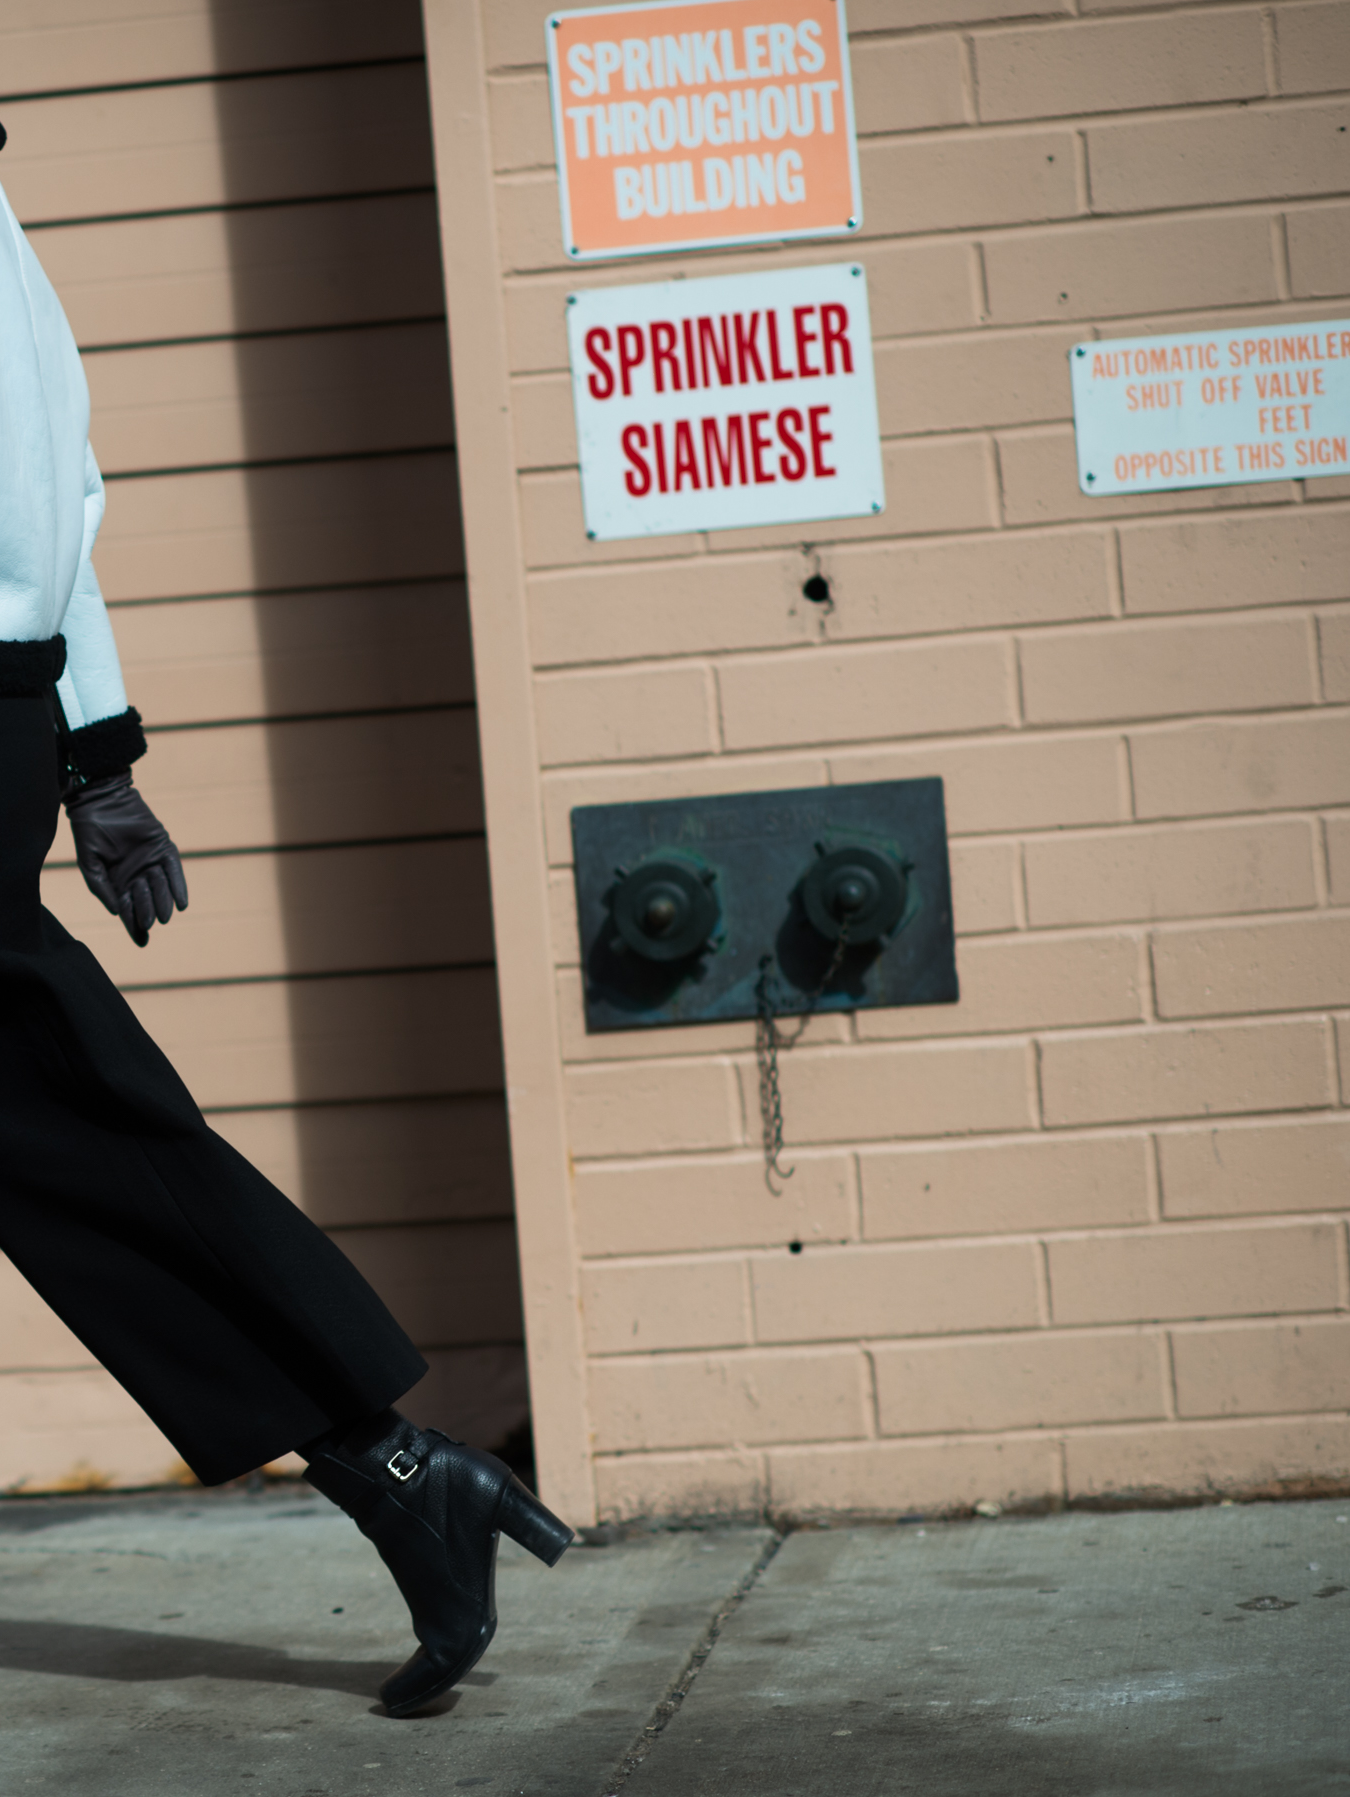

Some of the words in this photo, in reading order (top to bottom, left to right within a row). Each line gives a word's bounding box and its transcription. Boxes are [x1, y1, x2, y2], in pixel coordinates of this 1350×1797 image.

[566, 18, 826, 98] SPRINKLERS
[566, 80, 839, 160] THROUGHOUT
[613, 148, 806, 221] BUILDING
[584, 302, 854, 402] SPRINKLER
[1092, 342, 1219, 379] AUTOMATIC
[1228, 330, 1350, 368] SPRINKLER
[1125, 380, 1184, 412] SHUT
[1201, 374, 1242, 405] OFF
[1255, 368, 1325, 399] VALVE
[1258, 404, 1312, 434] FEET
[620, 404, 837, 498] SIAMESE
[1114, 446, 1224, 481] OPPOSITE
[1234, 441, 1285, 470] THIS
[1294, 437, 1348, 466] SIGN
